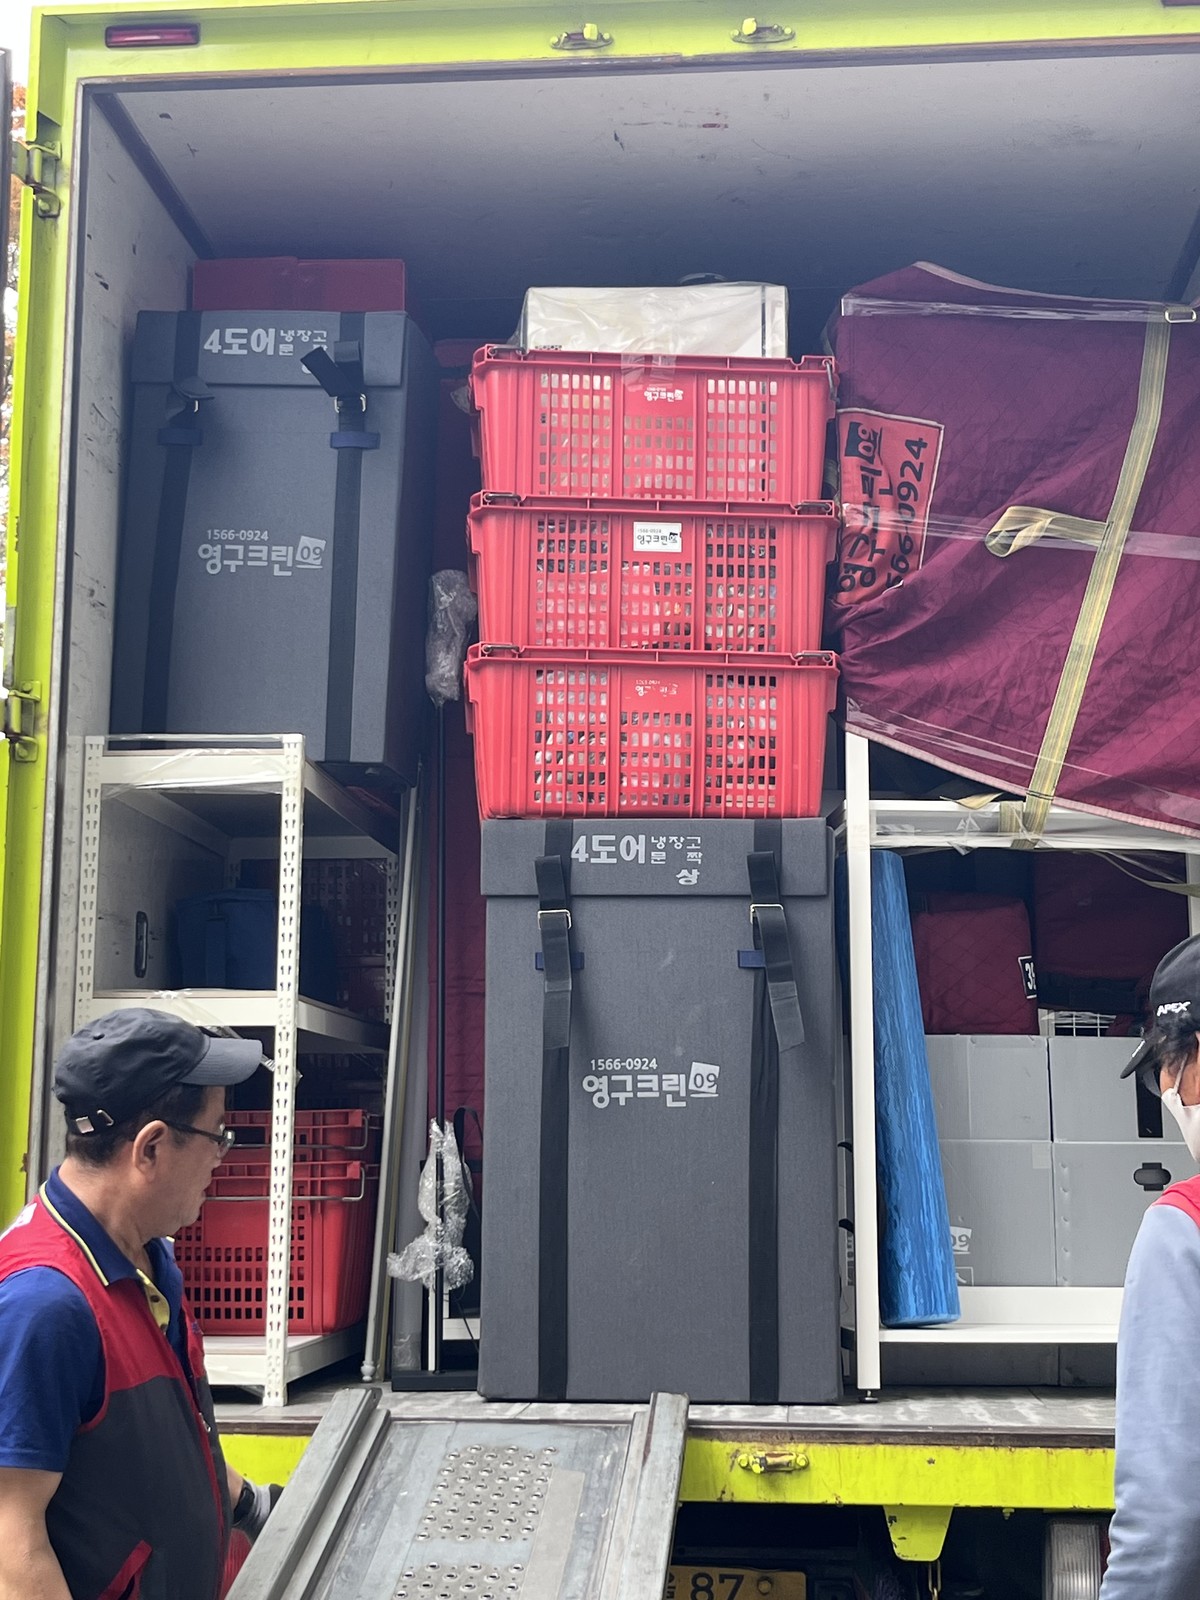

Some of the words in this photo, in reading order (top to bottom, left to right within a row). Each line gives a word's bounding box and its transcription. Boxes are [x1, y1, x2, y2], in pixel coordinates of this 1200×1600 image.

[203, 328, 276, 356] 4도어
[279, 330, 328, 343] 냉장고
[886, 437, 929, 589] 566-0924
[207, 529, 269, 541] 1566-0924
[197, 543, 294, 577] 영구크린
[570, 834, 646, 864] 4도어
[650, 836, 701, 850] 냉장고
[675, 868, 700, 886] 상
[1156, 1001, 1191, 1017] APEX
[590, 1058, 658, 1071] 1566-0924
[582, 1073, 687, 1109] 영구크린
[689, 1572, 745, 1600] 87
